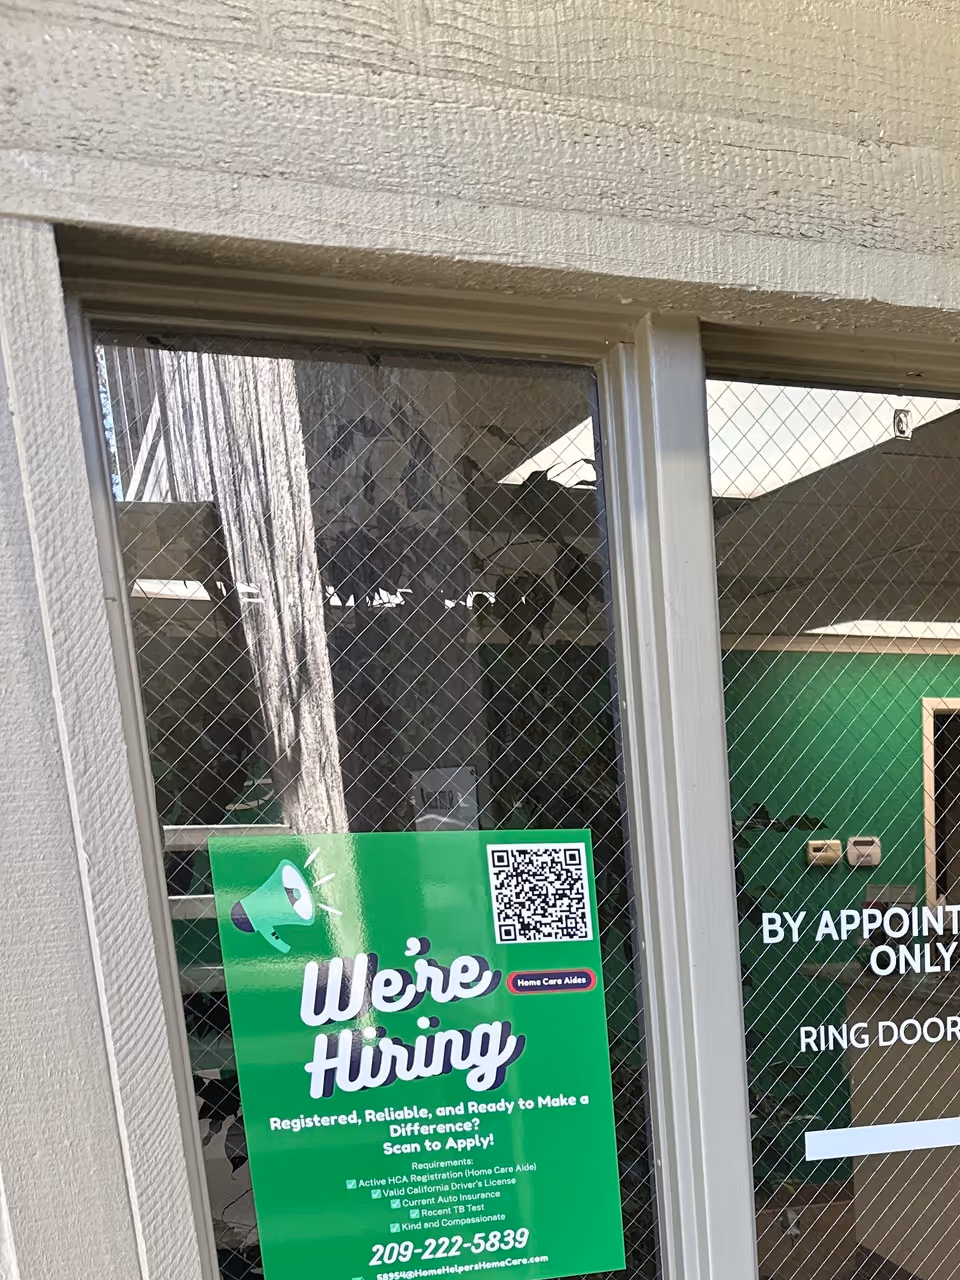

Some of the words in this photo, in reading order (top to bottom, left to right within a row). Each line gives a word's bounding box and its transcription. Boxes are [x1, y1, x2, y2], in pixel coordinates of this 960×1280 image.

[761, 910, 807, 945] BY
[869, 941, 959, 977] ONLY
[299, 937, 499, 1027] We're
[517, 978, 541, 987] Home
[542, 977, 562, 986] Care
[563, 975, 587, 985] Aides
[799, 1021, 870, 1054] RING
[304, 1015, 523, 1100] Hiring
[269, 1109, 362, 1132] Registered,
[364, 1105, 433, 1123] Reliable,
[435, 1101, 465, 1116] and
[467, 1098, 515, 1115] Ready
[518, 1097, 535, 1110] to
[537, 1093, 577, 1109] Make
[579, 1094, 589, 1105] a
[389, 1117, 481, 1138] Difference?
[382, 1141, 421, 1156] Scan
[424, 1138, 442, 1151] to
[444, 1132, 495, 1152] Apply!
[358, 1177, 387, 1188] Active
[387, 1175, 409, 1185] HCA
[410, 1170, 463, 1183] Registration
[464, 1167, 493, 1178] (Home
[493, 1165, 514, 1175] Care
[515, 1162, 537, 1173] Aide)
[411, 1157, 474, 1171] Requirements:
[382, 1187, 406, 1198] Valid
[406, 1183, 450, 1195] California
[450, 1180, 483, 1191] Driver's
[484, 1177, 517, 1187] License
[402, 1196, 436, 1207] Current
[437, 1194, 458, 1204] Auto
[459, 1190, 501, 1202] Insurance
[401, 1221, 422, 1231] Kind
[423, 1219, 440, 1229] and
[441, 1213, 506, 1227] Compassionate
[421, 1206, 452, 1217] Recent
[453, 1205, 466, 1214] TB
[466, 1203, 485, 1212] Test
[368, 1227, 530, 1267] 209-222-5839
